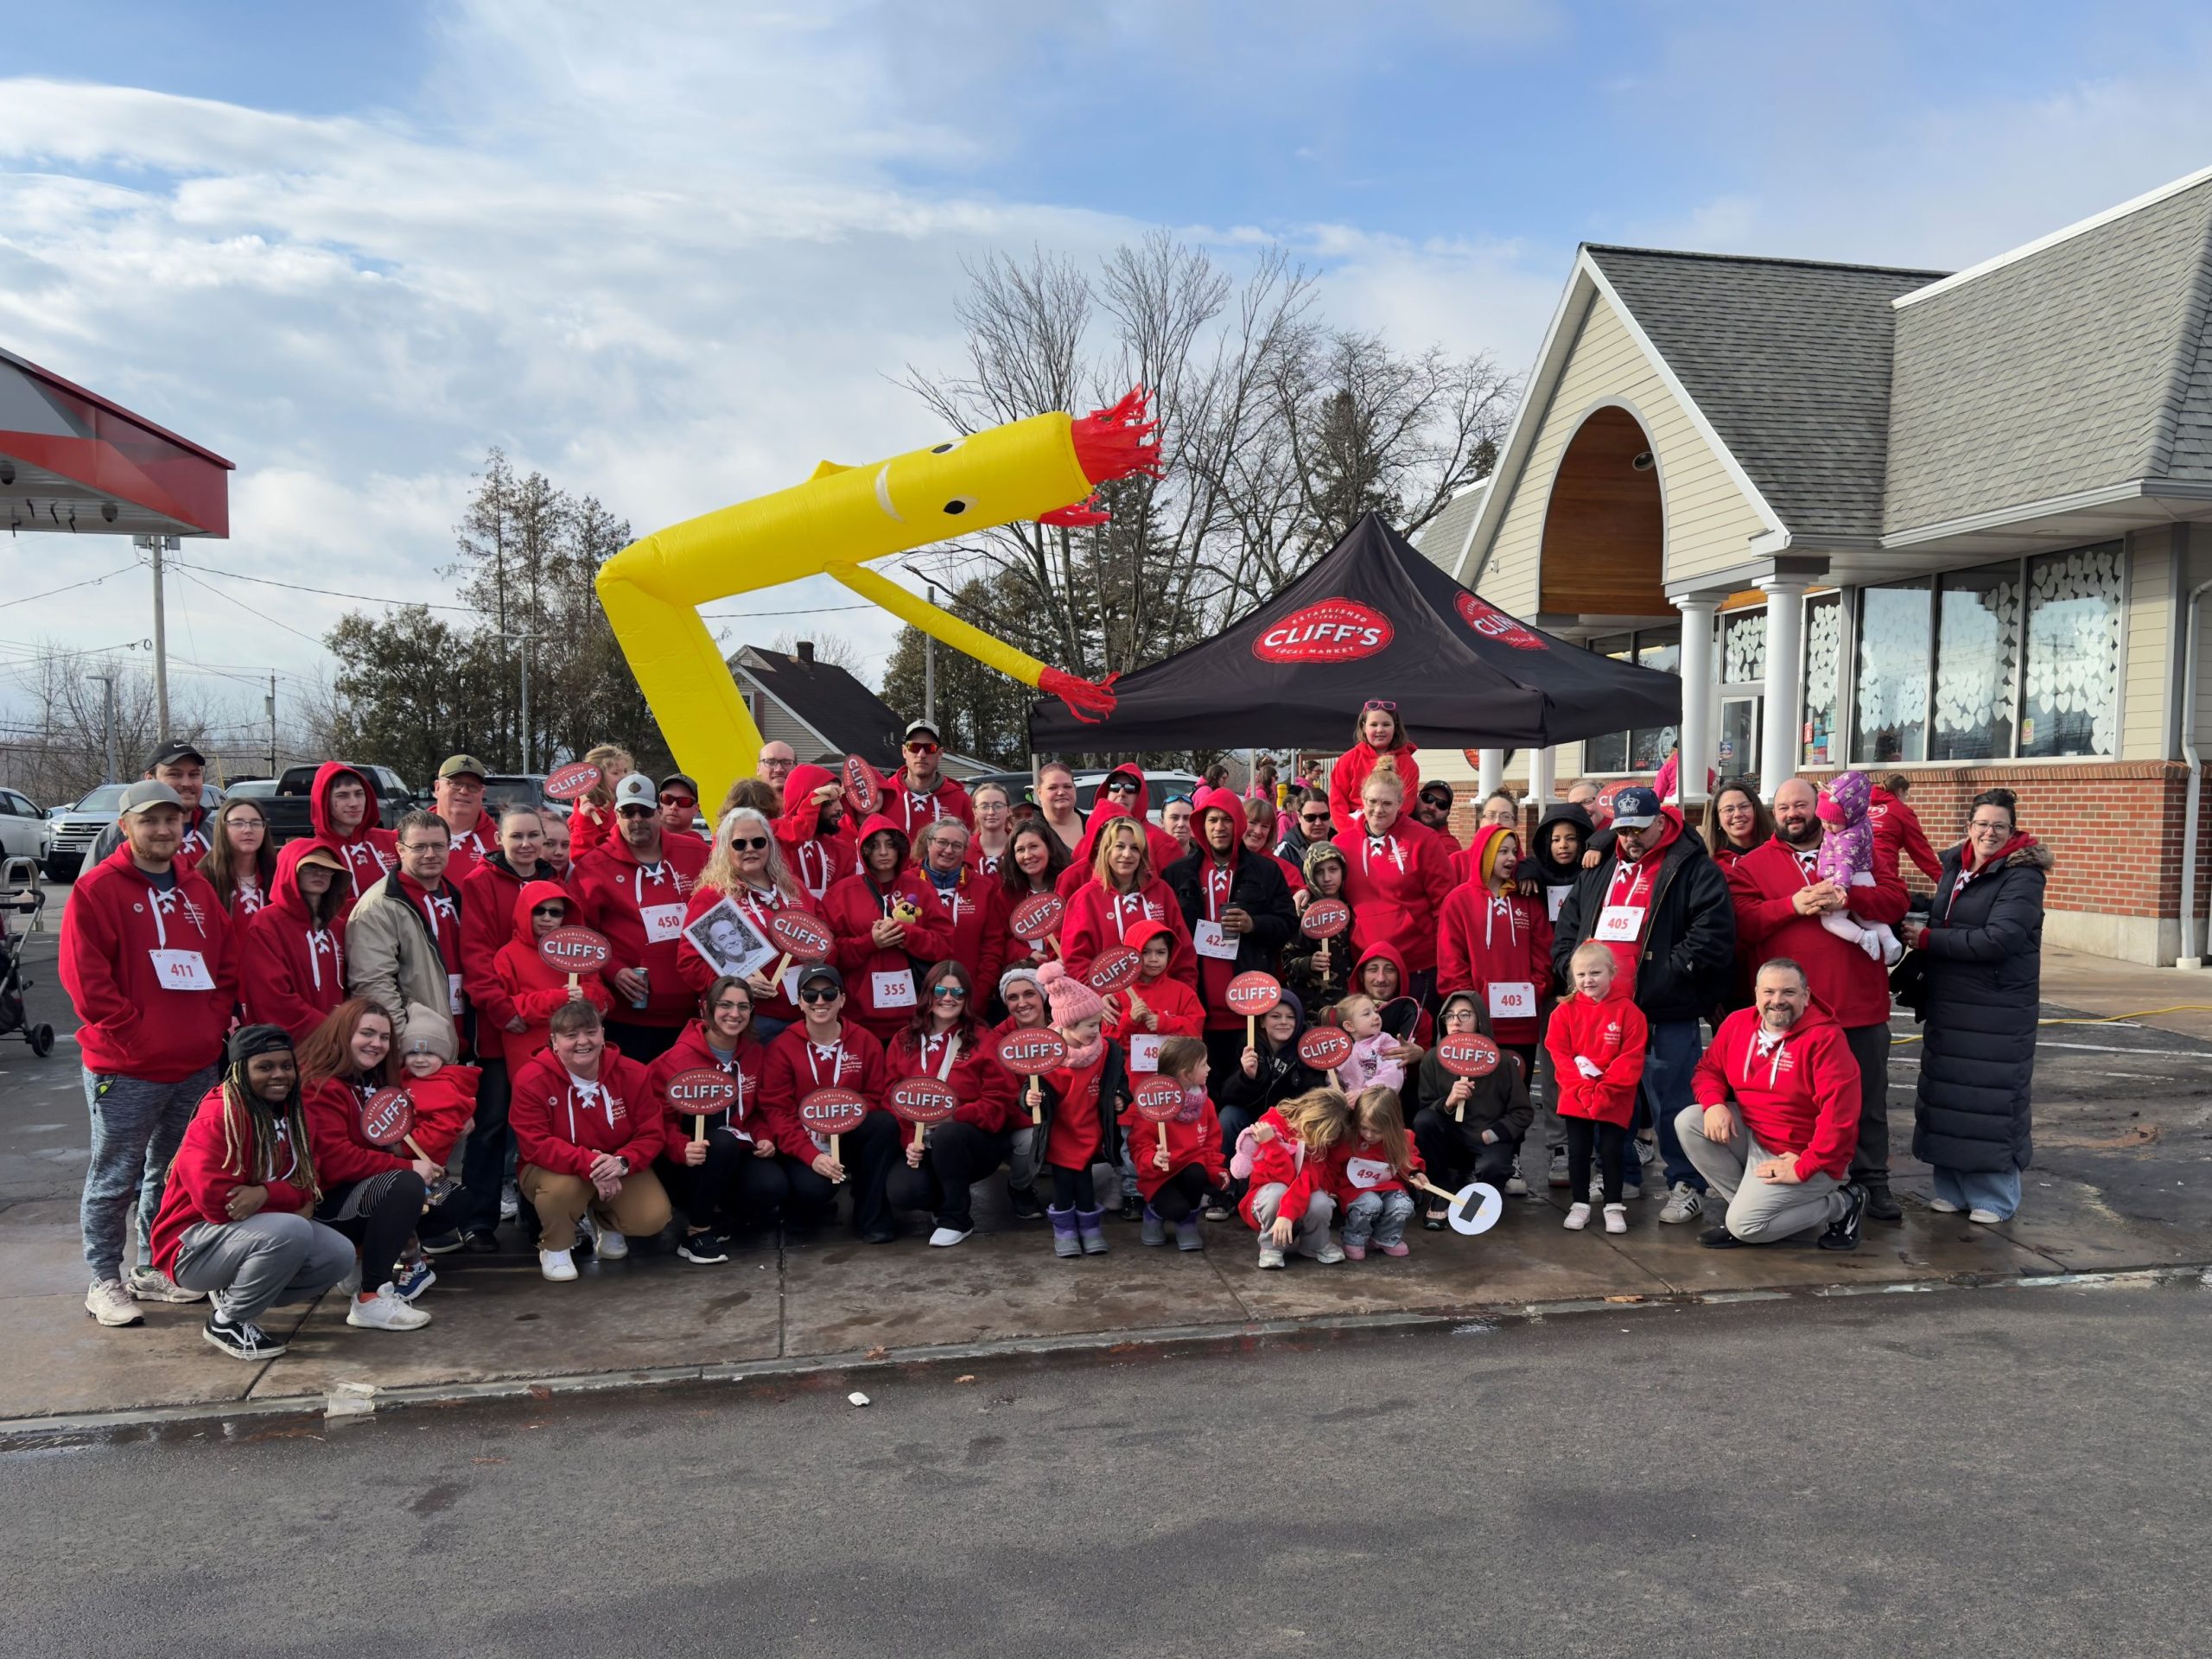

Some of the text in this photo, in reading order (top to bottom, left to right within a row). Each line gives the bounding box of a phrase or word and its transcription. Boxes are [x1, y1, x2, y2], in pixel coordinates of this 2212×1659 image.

[1292, 607, 1367, 624] ESTABLISHED
[1264, 622, 1382, 647] CLIFF'S
[549, 768, 597, 793] CLIFF'S
[849, 759, 871, 808] CLIFF'S
[658, 916, 679, 928] 450
[1015, 899, 1062, 933] CLIFF'S
[1304, 910, 1346, 928] CLIFF'S
[1608, 918, 1629, 930] 405
[774, 918, 829, 950] CLIFF'S
[1205, 934, 1227, 947] 42
[543, 940, 606, 960] CLIFF'S
[171, 963, 194, 977] 411
[1092, 952, 1140, 986] CLIFF'S
[884, 983, 906, 995] 355
[1229, 987, 1277, 1001] CLIFF'S
[1501, 995, 1522, 1007] 403
[1002, 1042, 1063, 1059] CLIFF'S
[1143, 1046, 1159, 1058] 48
[1301, 1037, 1349, 1058] CLIFF'S
[1440, 1045, 1496, 1064] CLIFF'S
[671, 1084, 734, 1098] CLIFF'S
[895, 1090, 953, 1109] CLIFF'S
[1137, 1090, 1182, 1106] CLIFF'S
[367, 1094, 408, 1138] CLIFF'S
[803, 1103, 863, 1118] CLIFF'S
[1357, 1169, 1382, 1181] 494
